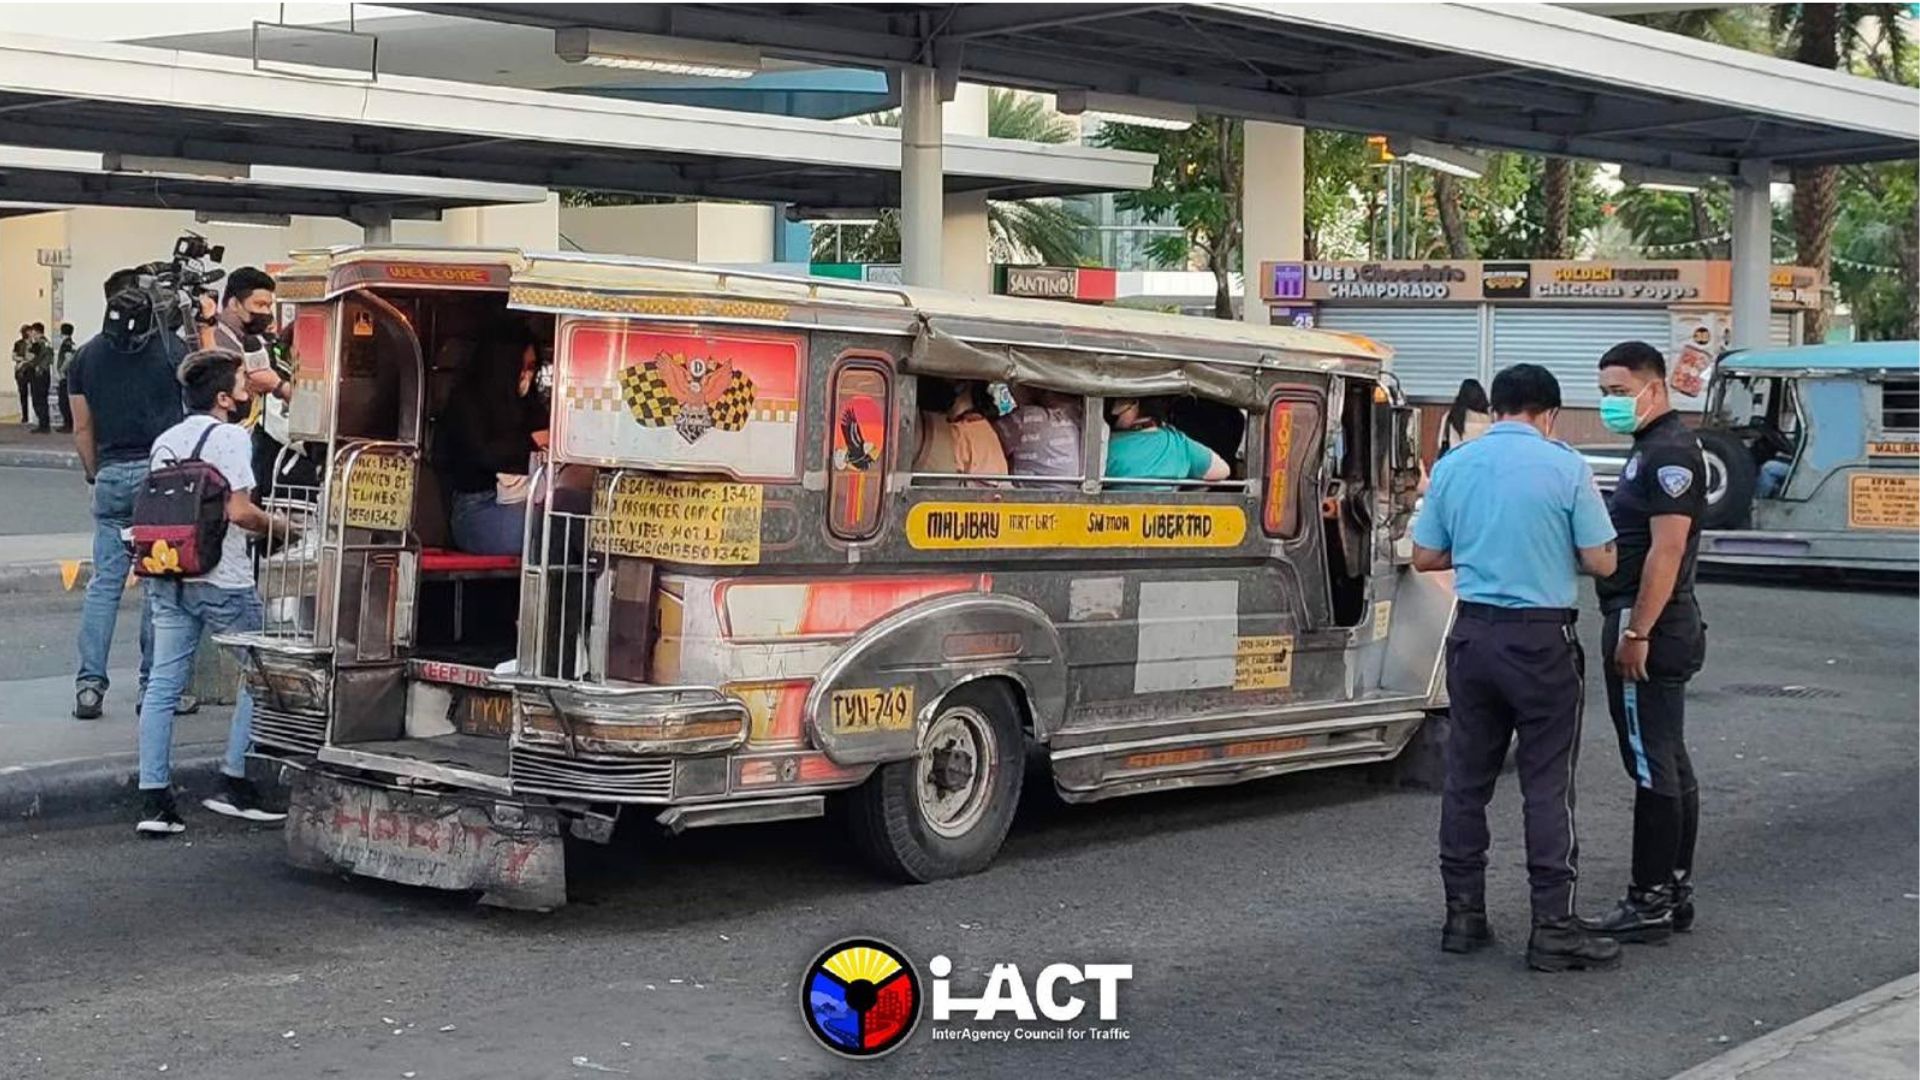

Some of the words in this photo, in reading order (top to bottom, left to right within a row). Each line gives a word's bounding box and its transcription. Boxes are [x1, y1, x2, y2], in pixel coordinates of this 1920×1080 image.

[389, 266, 487, 281] WELCOME
[1555, 267, 1612, 281] GOLDEN
[1010, 273, 1075, 294] SANTINO'S
[1328, 284, 1450, 299] CHAMPORADO
[1536, 283, 1624, 298] Chicken
[721, 485, 758, 503] 1342
[927, 511, 1000, 541] MALIBAY
[1142, 513, 1212, 539] LIBERTAD
[423, 662, 459, 682] KEEP
